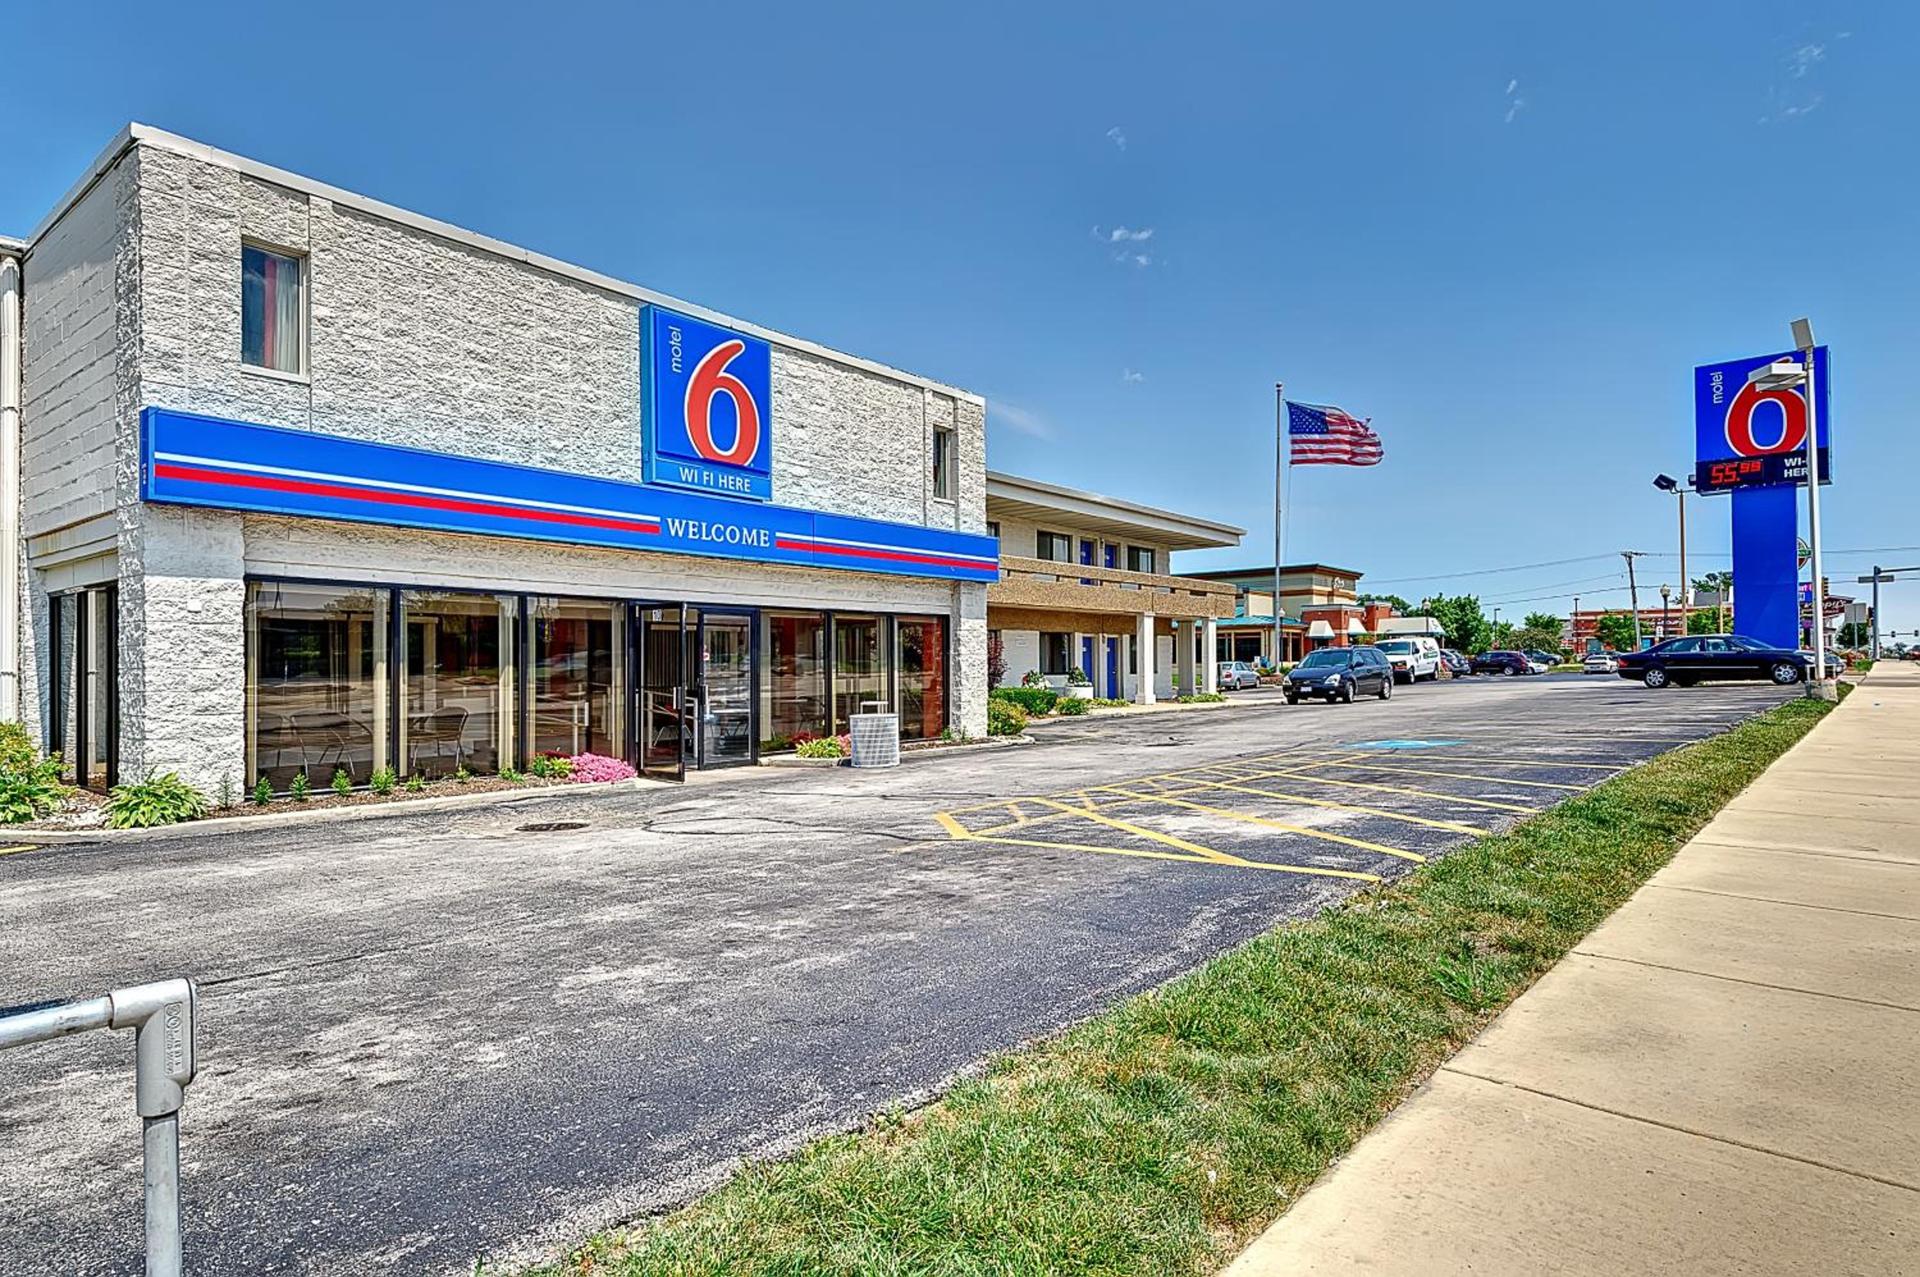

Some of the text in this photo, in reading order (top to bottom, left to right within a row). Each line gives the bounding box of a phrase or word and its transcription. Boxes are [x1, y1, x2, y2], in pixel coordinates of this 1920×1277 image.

[669, 326, 760, 468] motel 6
[1709, 371, 1723, 404] motel
[1784, 457, 1807, 467] WI-
[1784, 468, 1808, 478] HER
[679, 466, 751, 492] WI FI HERE
[666, 517, 770, 548] WELCOME
